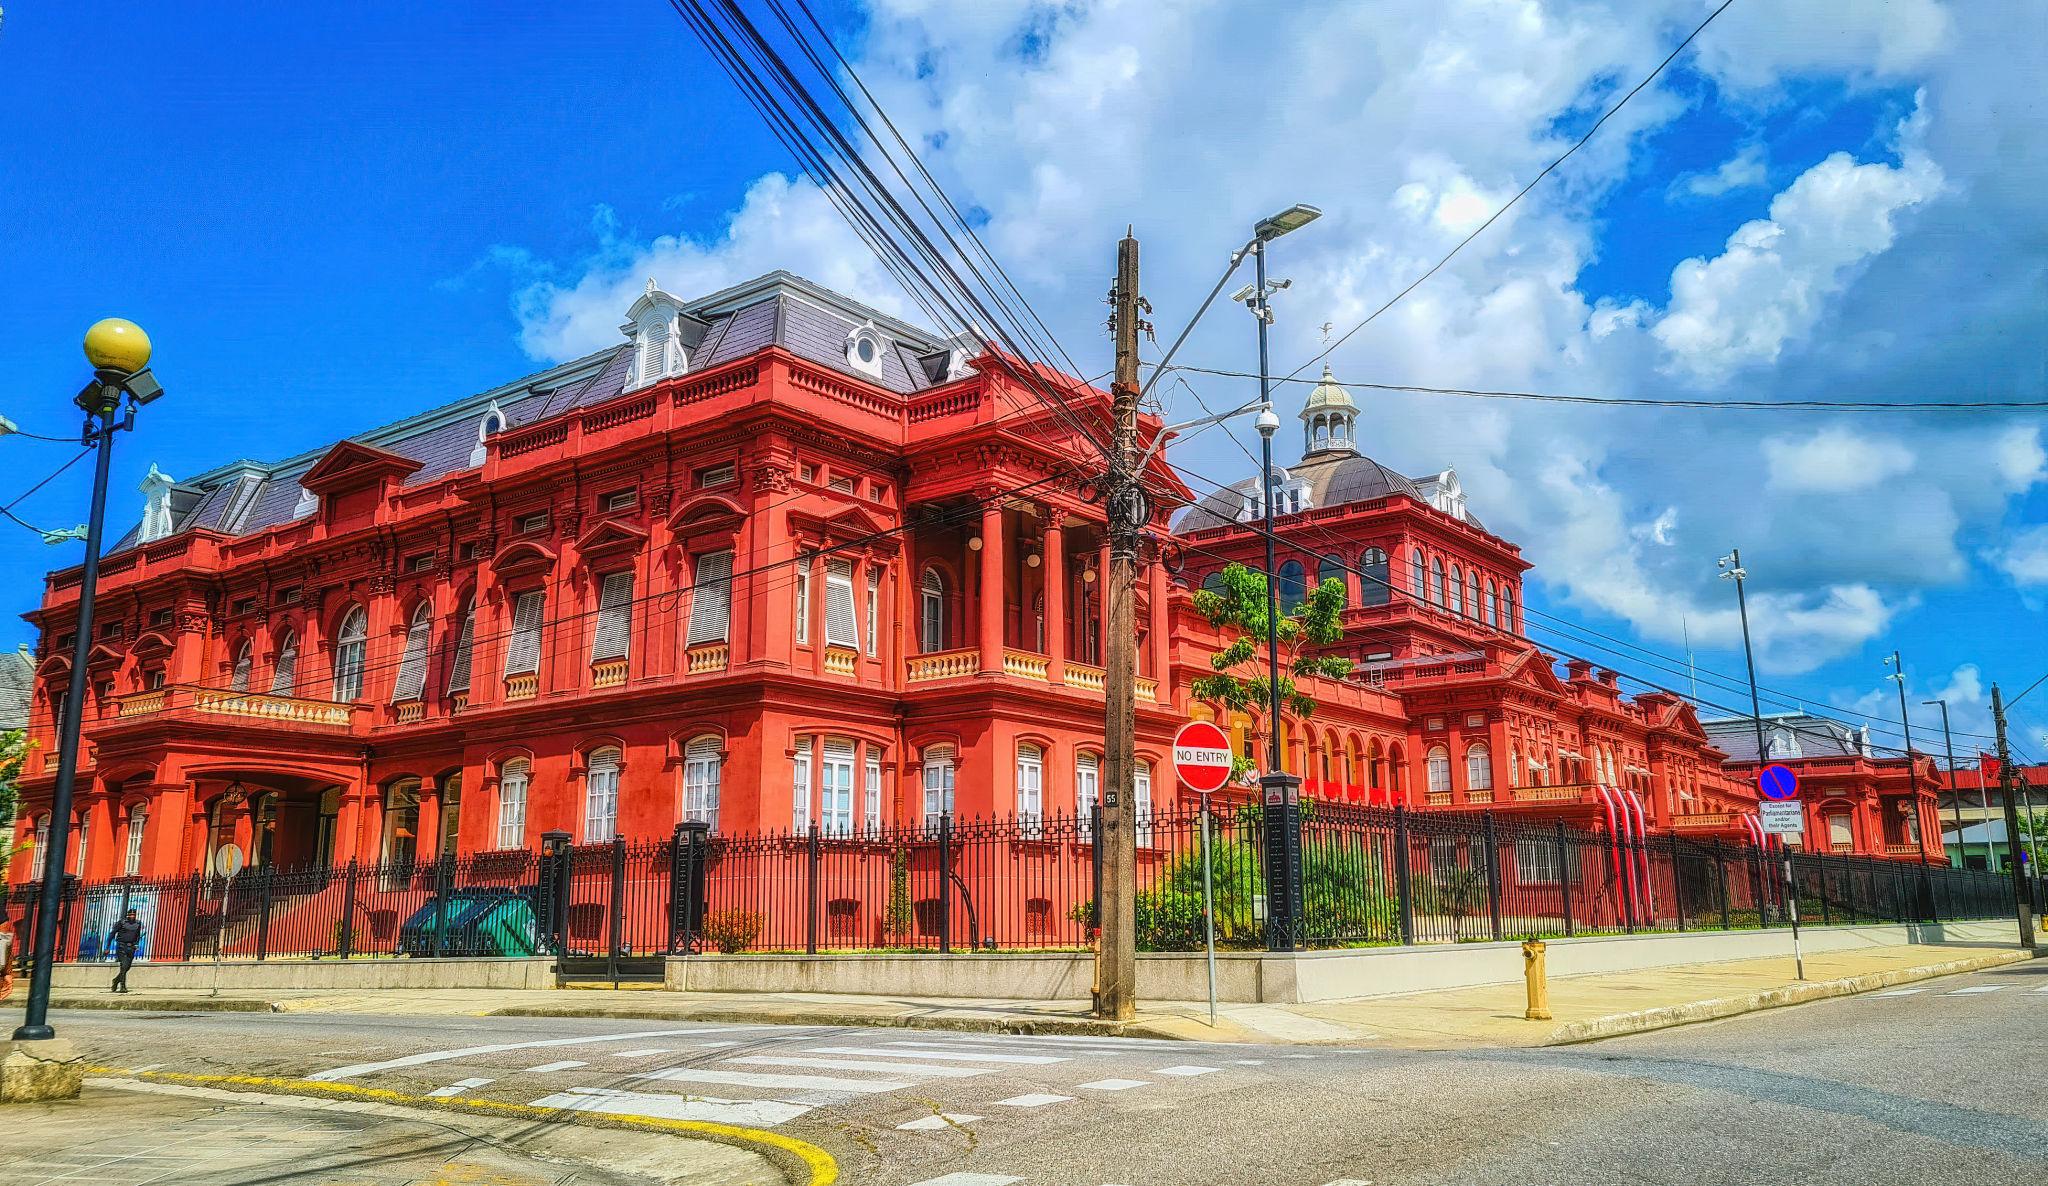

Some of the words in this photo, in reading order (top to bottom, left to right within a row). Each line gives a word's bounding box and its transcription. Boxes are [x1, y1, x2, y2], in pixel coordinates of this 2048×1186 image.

[1177, 750, 1192, 761] NO
[1196, 751, 1228, 763] ENTRY
[1106, 794, 1116, 803] 55
